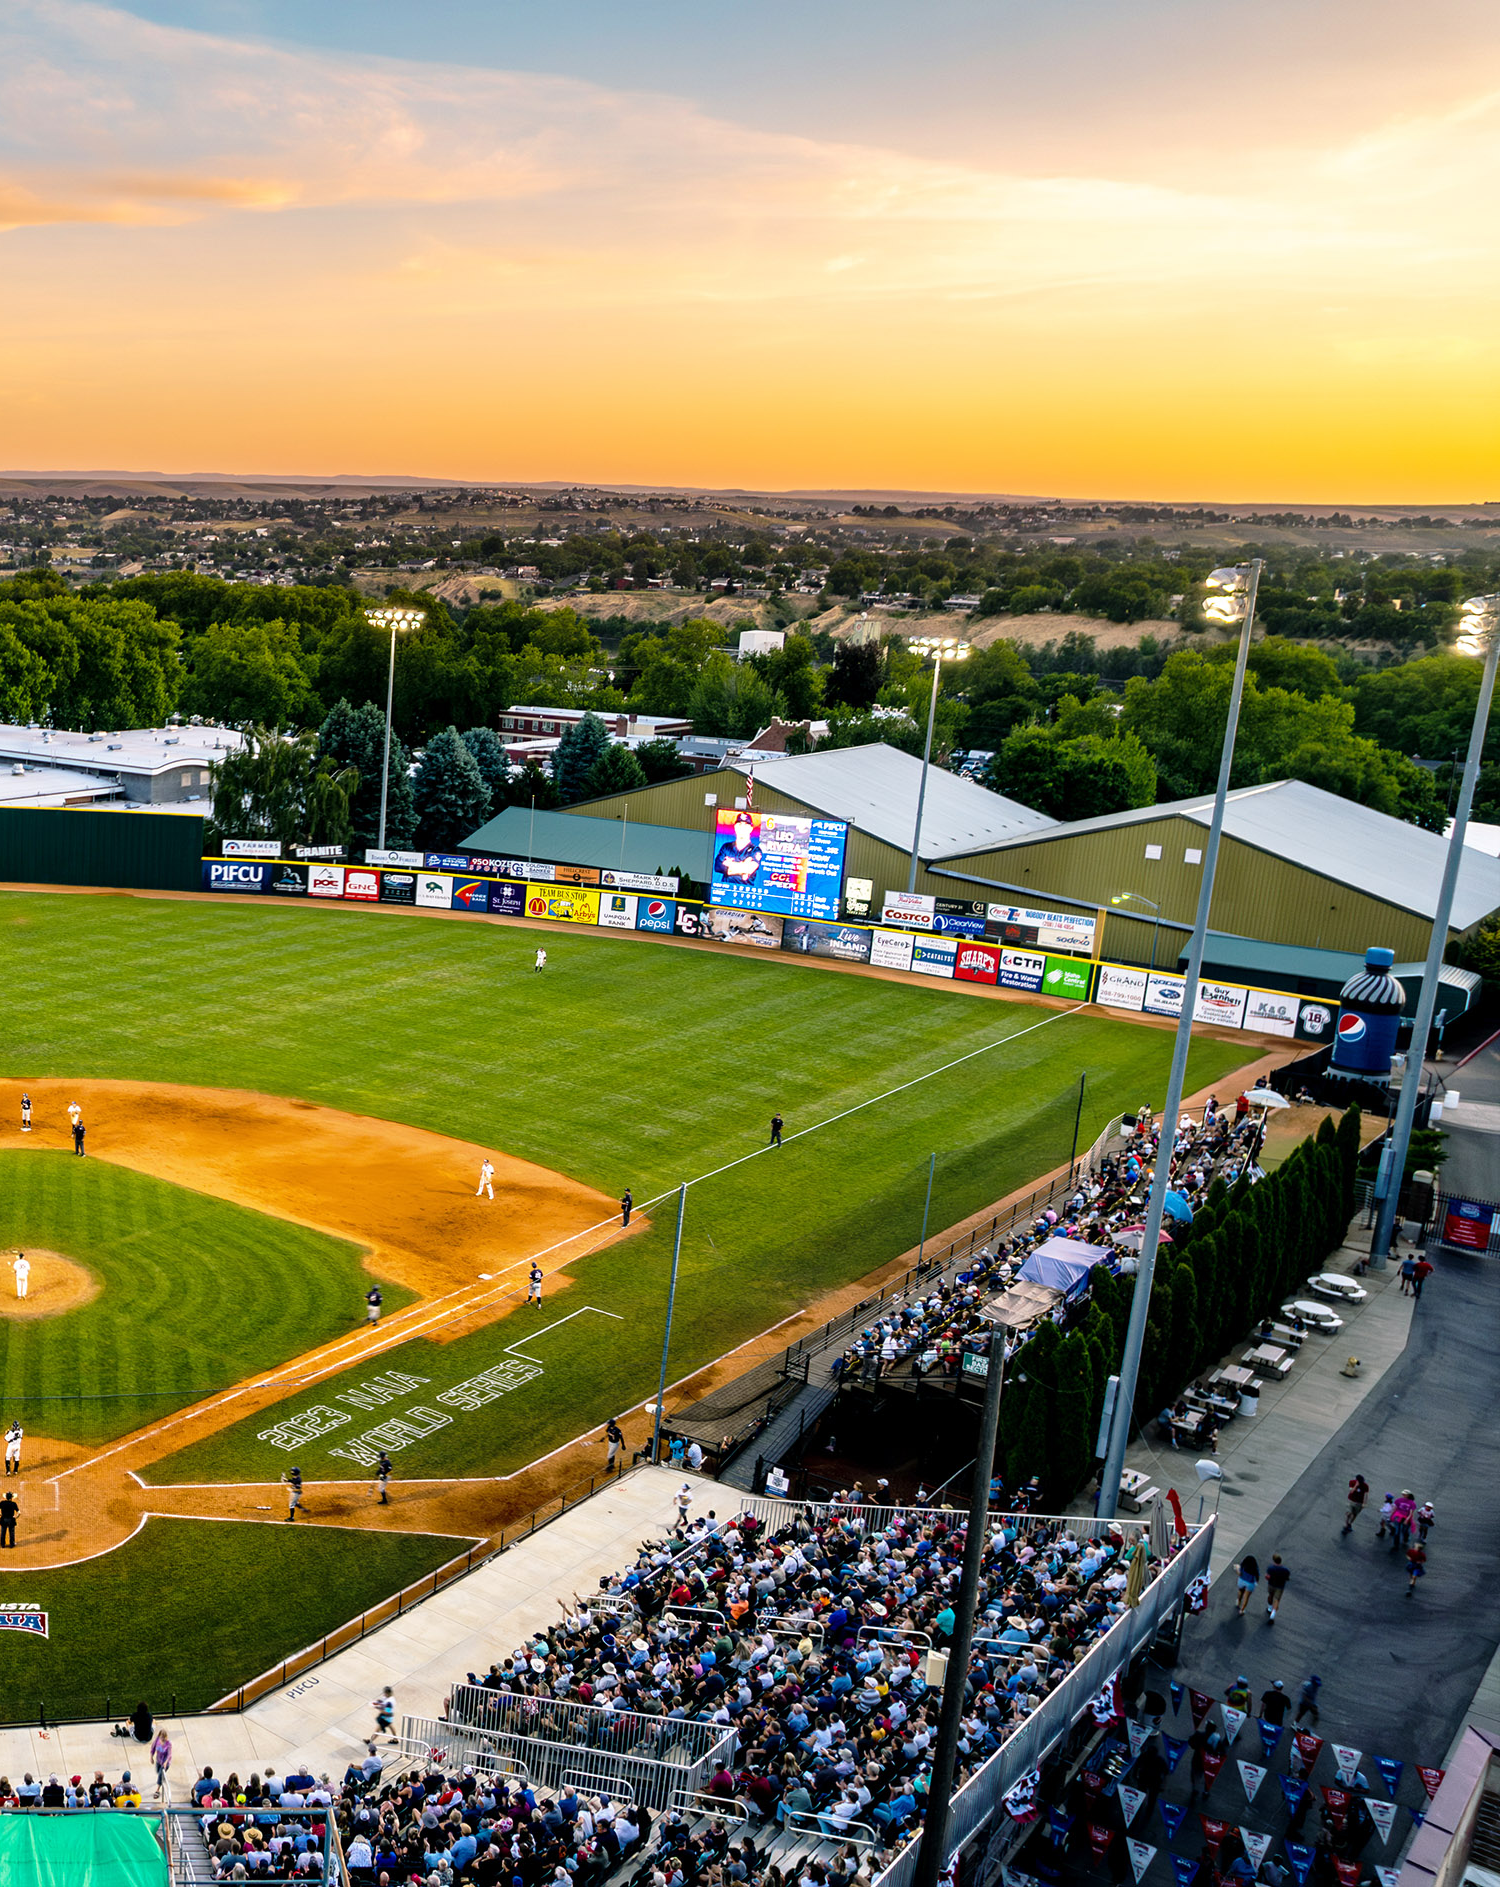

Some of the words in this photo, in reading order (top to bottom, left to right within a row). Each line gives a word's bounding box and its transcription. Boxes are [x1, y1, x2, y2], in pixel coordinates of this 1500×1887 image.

[766, 817, 775, 830] 6
[776, 831, 794, 842] LEO
[295, 845, 343, 857] GRANITE
[767, 841, 801, 854] RIVERA
[525, 862, 555, 870] COLDWELL
[563, 867, 591, 875] HILLCREST
[618, 877, 654, 886] SHEPPARD,
[655, 880, 676, 889] D.D.S.
[540, 888, 556, 898] TEAM
[557, 890, 570, 899] BUS
[570, 892, 587, 901] STOP
[574, 909, 596, 919] Arby's
[604, 913, 631, 921] UMPQUA
[676, 906, 698, 934] LC
[715, 909, 746, 919] GUARDIAN
[885, 909, 930, 923] COSTCO
[1025, 910, 1046, 920] NOBODY
[1046, 913, 1062, 922] BEATS
[1064, 915, 1095, 927] PERFECTION
[639, 918, 671, 930] pepsi
[948, 918, 985, 929] ClearView
[837, 928, 860, 942] Live
[1056, 935, 1090, 946] sodexo
[829, 939, 868, 952] INLAND
[876, 936, 905, 948] EyeCare
[926, 952, 954, 962] CATALYST
[1012, 956, 1043, 970] CTR
[1001, 978, 1037, 989] Restoration
[1020, 974, 1039, 983] Water
[1063, 977, 1086, 985] Central
[1149, 978, 1186, 988] ROGER
[1214, 986, 1230, 995] Guy
[1209, 992, 1241, 1006] Bennett
[256, 1405, 352, 1452] 2023
[334, 1370, 432, 1411] NAIA
[327, 1406, 454, 1467] WORLD
[435, 1359, 545, 1412] SERIES
